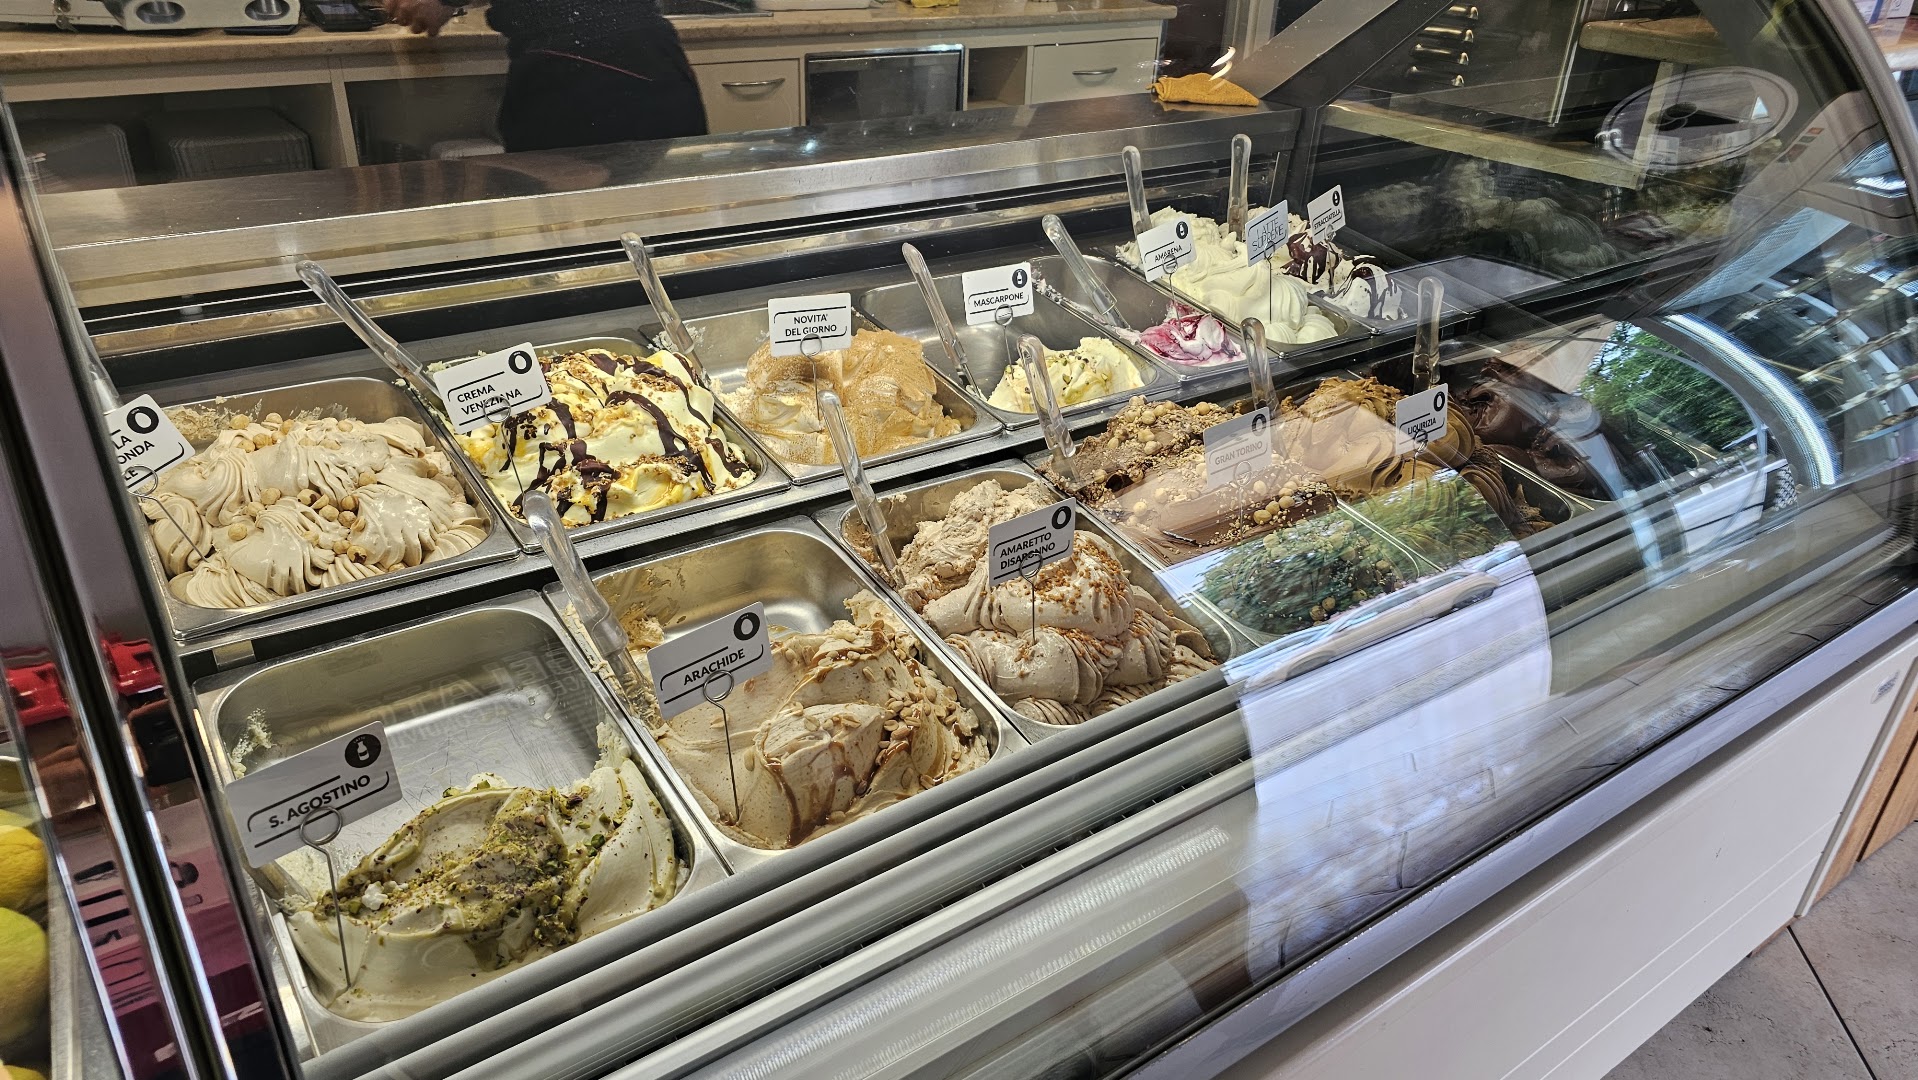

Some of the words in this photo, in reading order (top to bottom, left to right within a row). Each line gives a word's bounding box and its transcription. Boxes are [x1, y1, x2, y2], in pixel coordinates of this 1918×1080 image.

[1256, 217, 1279, 239] LATTE
[1314, 209, 1341, 230] STRACCIATELLA
[1252, 224, 1284, 251] SUPREME
[1154, 245, 1182, 262] AMARENA
[973, 291, 1024, 307] MASCARPONE
[785, 328, 801, 337] DEL
[803, 324, 837, 335] GIORNO
[793, 314, 828, 325] NOVITA'
[457, 384, 496, 403] CREMA
[461, 388, 522, 415] VENEZIANA
[1407, 417, 1437, 435] LIQUIRIZIA
[117, 440, 155, 465] ONDA
[1215, 450, 1235, 465] GRAN
[1236, 441, 1263, 457] TORINO
[1000, 532, 1052, 558] AMARETTO
[1000, 542, 1056, 570] DISARONNO
[683, 648, 745, 686] ARACHIDE
[268, 815, 284, 829] S.
[287, 774, 371, 821] AGOSTINO
